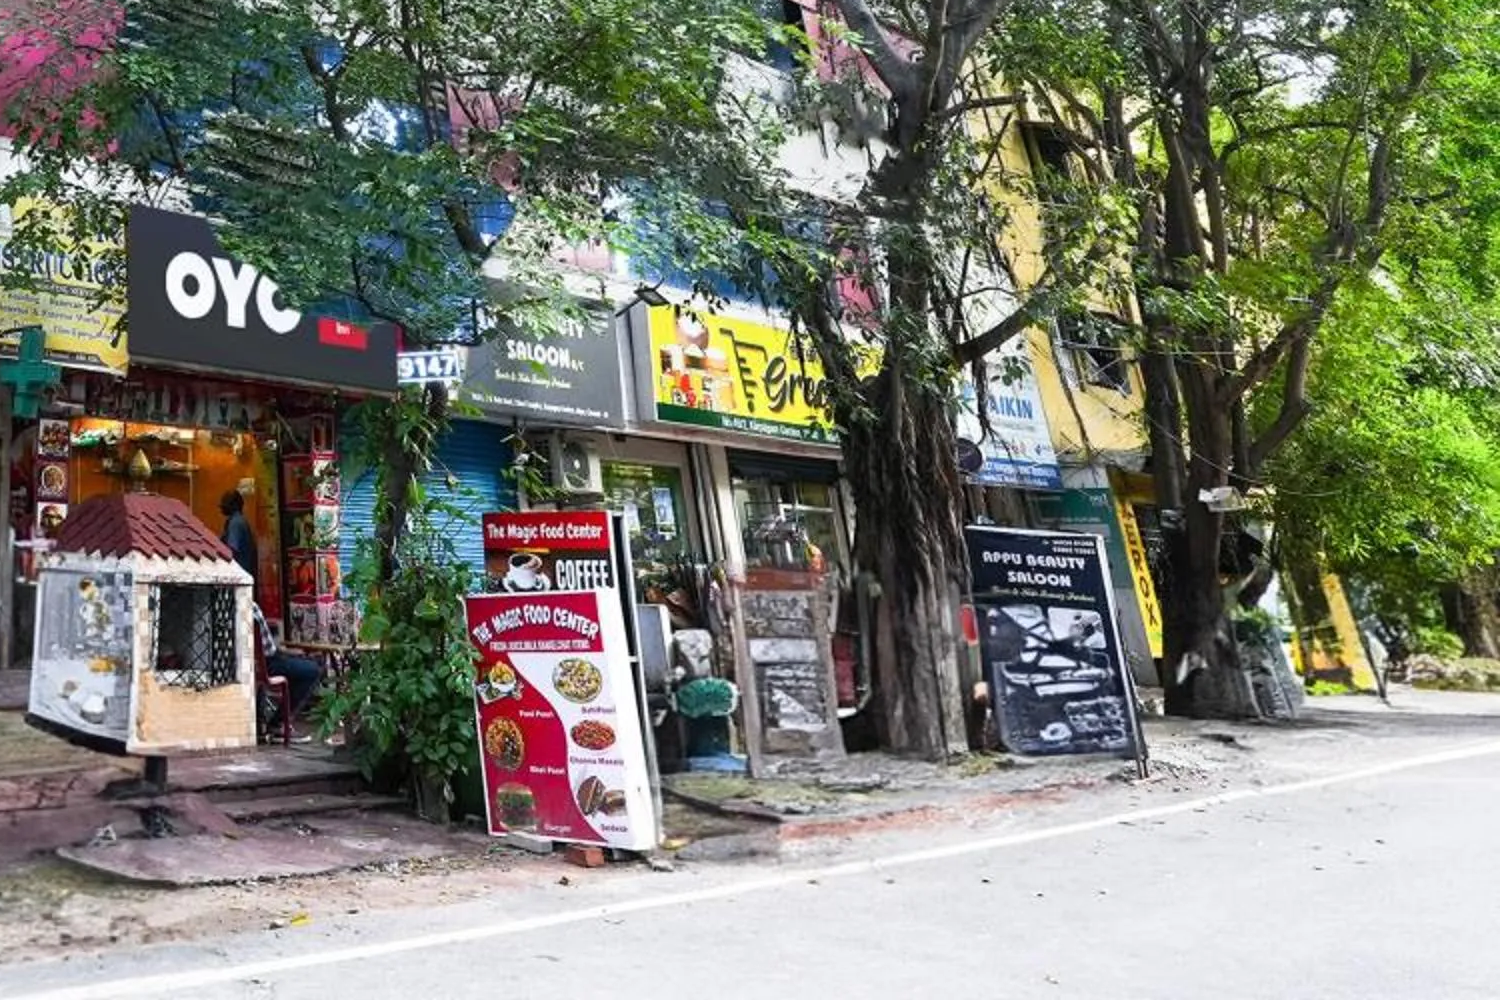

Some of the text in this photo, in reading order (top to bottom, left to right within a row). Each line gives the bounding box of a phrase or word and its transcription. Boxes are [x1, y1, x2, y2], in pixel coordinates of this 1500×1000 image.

[506, 339, 571, 369] SALOON
[988, 395, 1034, 419] AIKIN
[487, 522, 602, 544] The Magic Food Center
[982, 551, 1085, 570] APPU BEAUTY
[555, 559, 609, 590] COFFEE
[1007, 571, 1071, 587] SALOON
[472, 622, 492, 646] THE
[491, 606, 524, 633] MAGIC
[523, 604, 551, 625] FOOD
[553, 607, 598, 640] CENTER
